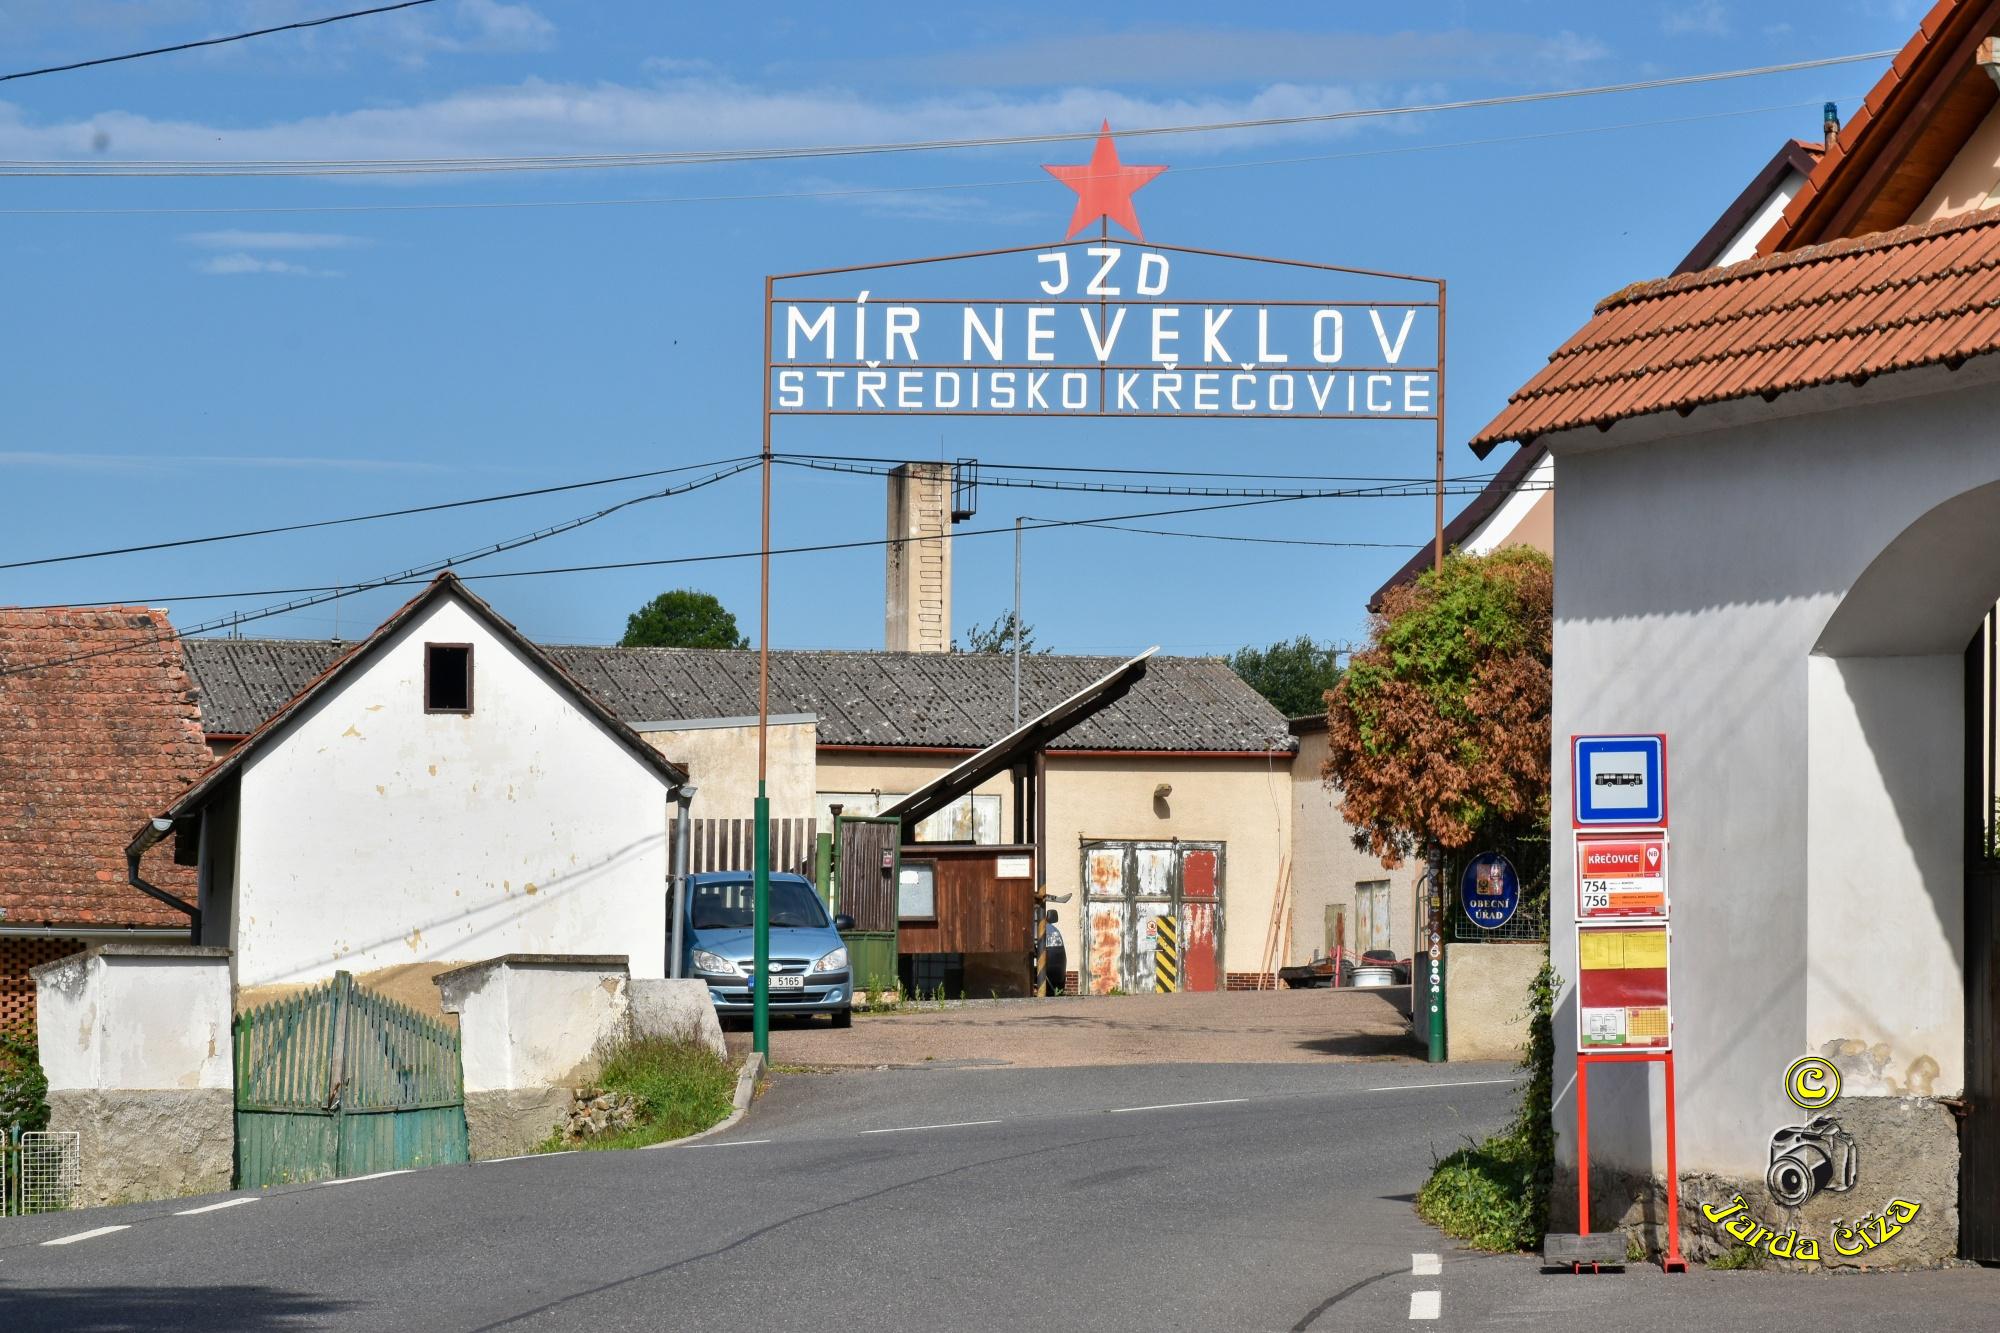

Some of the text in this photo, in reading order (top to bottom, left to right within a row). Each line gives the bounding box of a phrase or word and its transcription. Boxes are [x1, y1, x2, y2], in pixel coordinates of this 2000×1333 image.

[1038, 248, 1169, 296] JZD
[787, 290, 1416, 363] MÍR NEVEKLOV
[779, 361, 1430, 411] STŘEDISKO KŘEČOVICE
[1588, 853, 1639, 864] KŘEČOVICE
[1584, 881, 1607, 892] 754
[1470, 898, 1509, 909] OBECNÍ
[1584, 895, 1607, 906] 756
[1475, 909, 1504, 920] ÚŘAD
